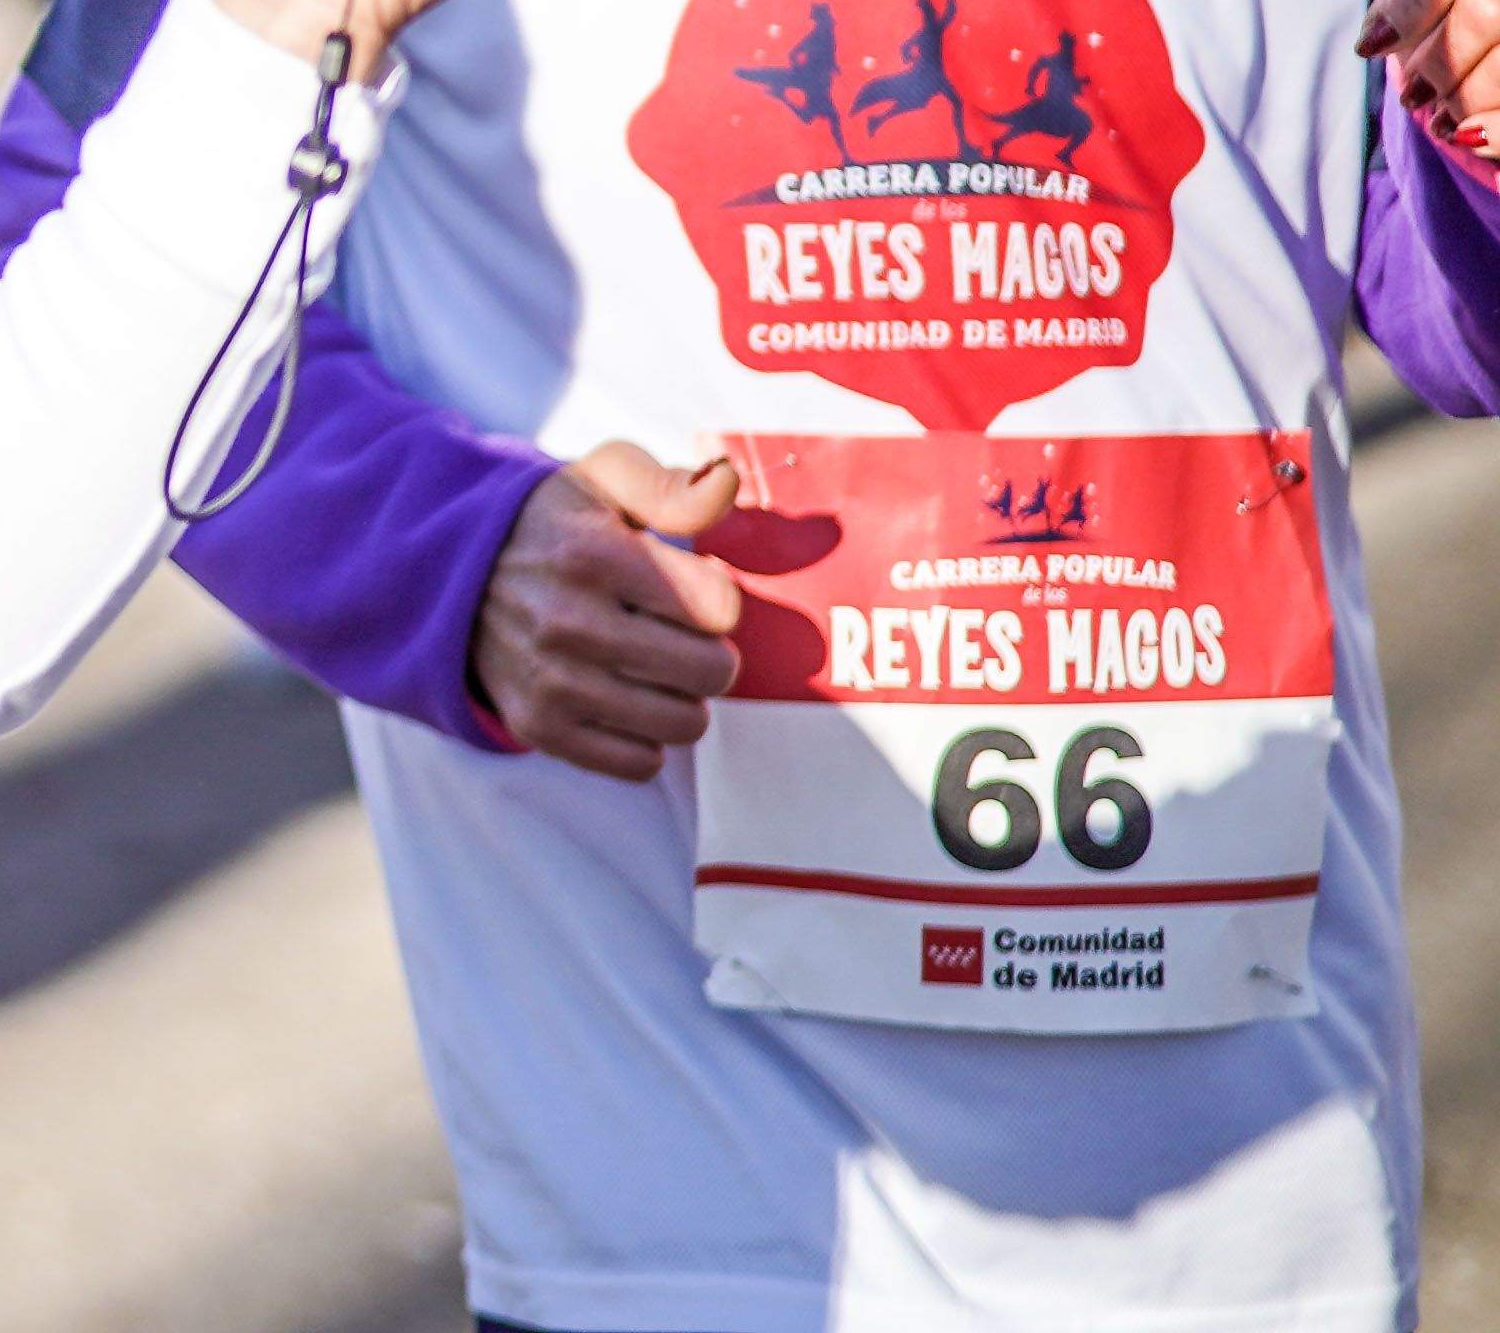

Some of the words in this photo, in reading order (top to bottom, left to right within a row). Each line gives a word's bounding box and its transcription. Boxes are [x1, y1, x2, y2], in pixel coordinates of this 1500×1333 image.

[776, 163, 941, 205] CARRERA
[949, 162, 1091, 205] POPULAR
[744, 219, 926, 305] REYES
[951, 221, 1126, 304] MAGOS
[748, 319, 950, 353] COMUNIDAD
[962, 319, 1007, 350] DE
[1015, 317, 1128, 348] MADRID
[890, 555, 1041, 590] CARRERA
[1046, 554, 1177, 591] POPULAR
[829, 605, 1024, 691] REYES
[1046, 603, 1226, 694] MAGOS
[931, 726, 1153, 871] 66
[993, 926, 1165, 954] Comunidad
[993, 961, 1038, 989] de
[1051, 960, 1165, 989] Madrid
